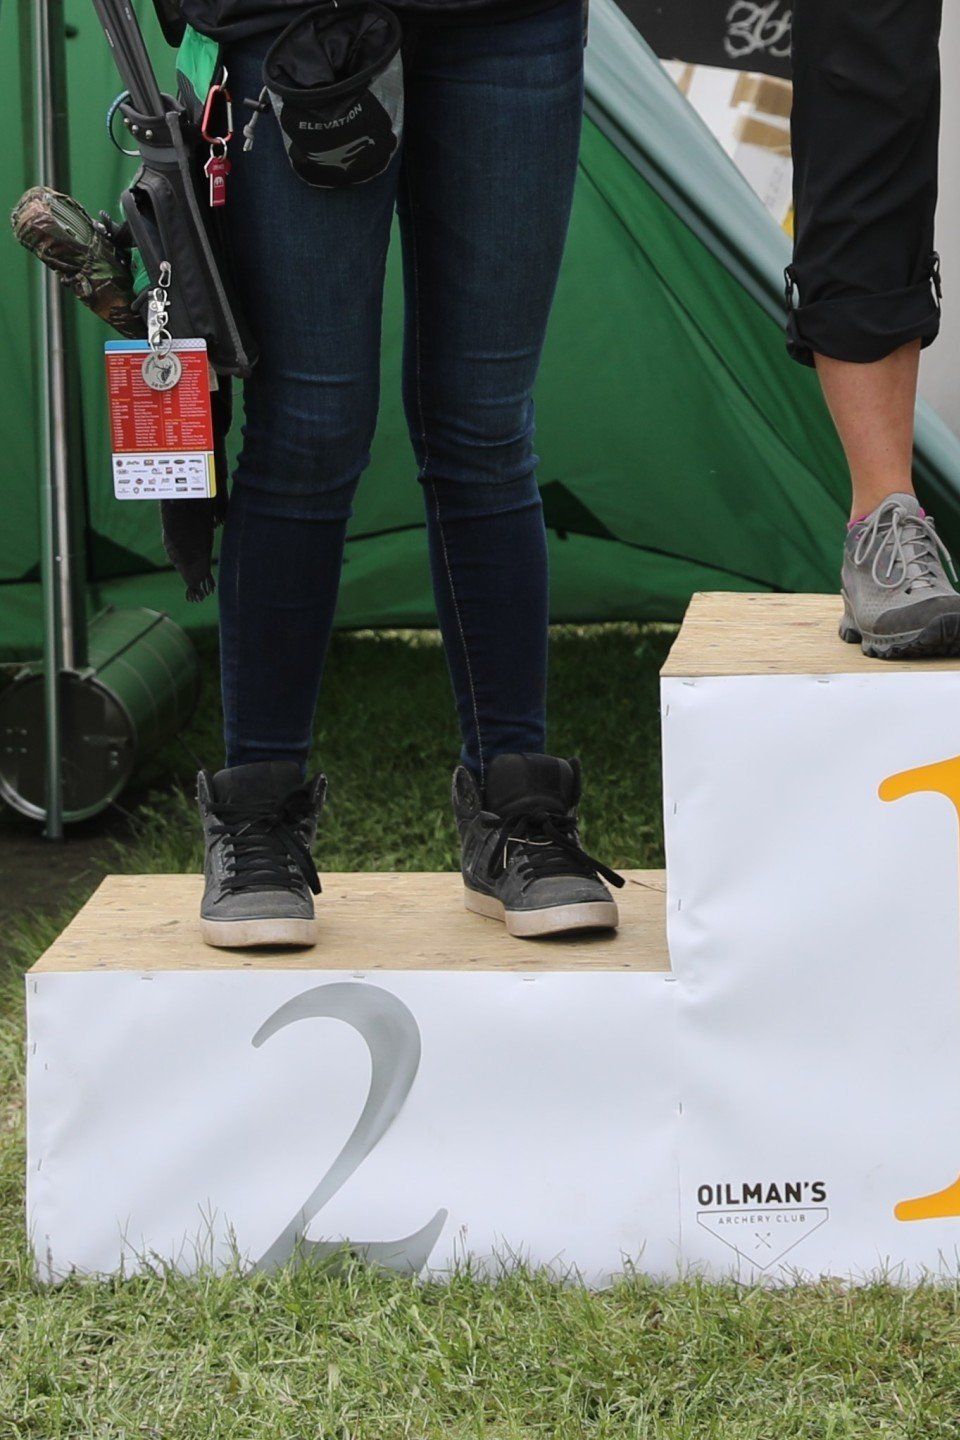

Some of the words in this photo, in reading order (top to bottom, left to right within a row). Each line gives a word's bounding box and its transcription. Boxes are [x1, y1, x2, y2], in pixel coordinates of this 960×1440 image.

[299, 103, 363, 130] ELEVATION
[248, 981, 449, 1277] 2
[697, 1181, 827, 1206] OILMAN'S
[718, 1214, 771, 1225] ARCHERY
[776, 1214, 806, 1223] CLUB
